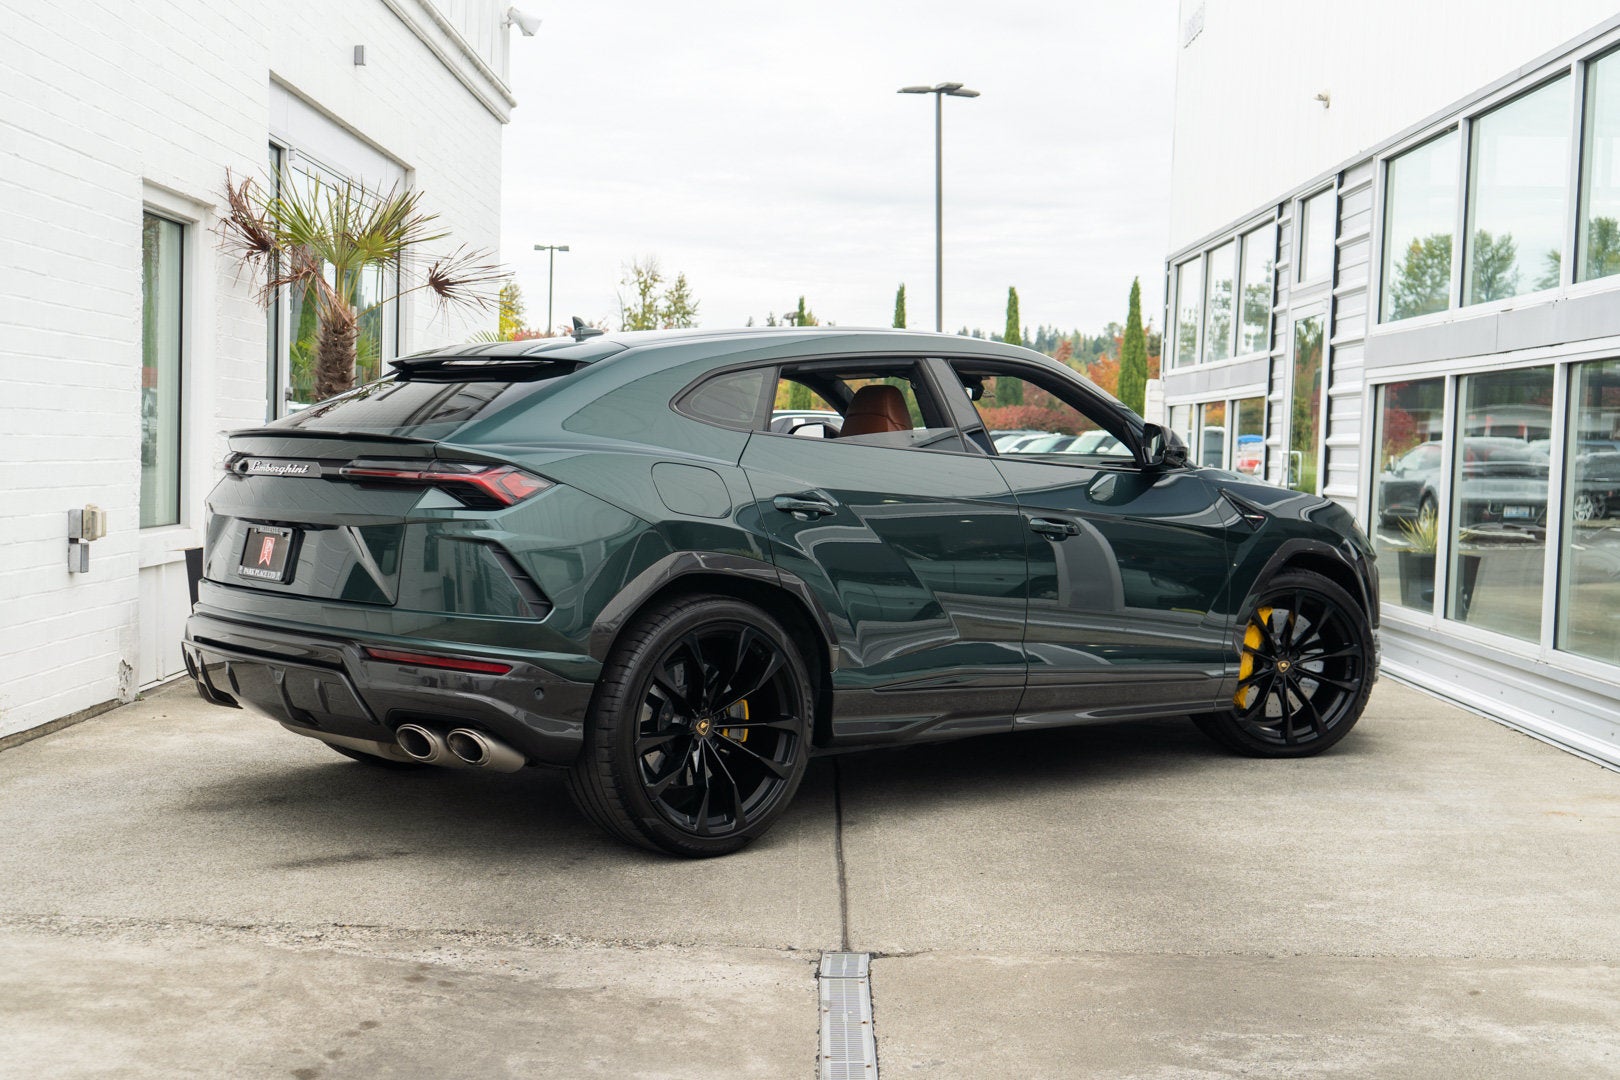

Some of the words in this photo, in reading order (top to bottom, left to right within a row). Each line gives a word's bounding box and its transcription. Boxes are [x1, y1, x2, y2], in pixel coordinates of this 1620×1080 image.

[250, 460, 309, 475] Lamborghini
[243, 567, 255, 576] PARK
[255, 569, 267, 578] PLACE
